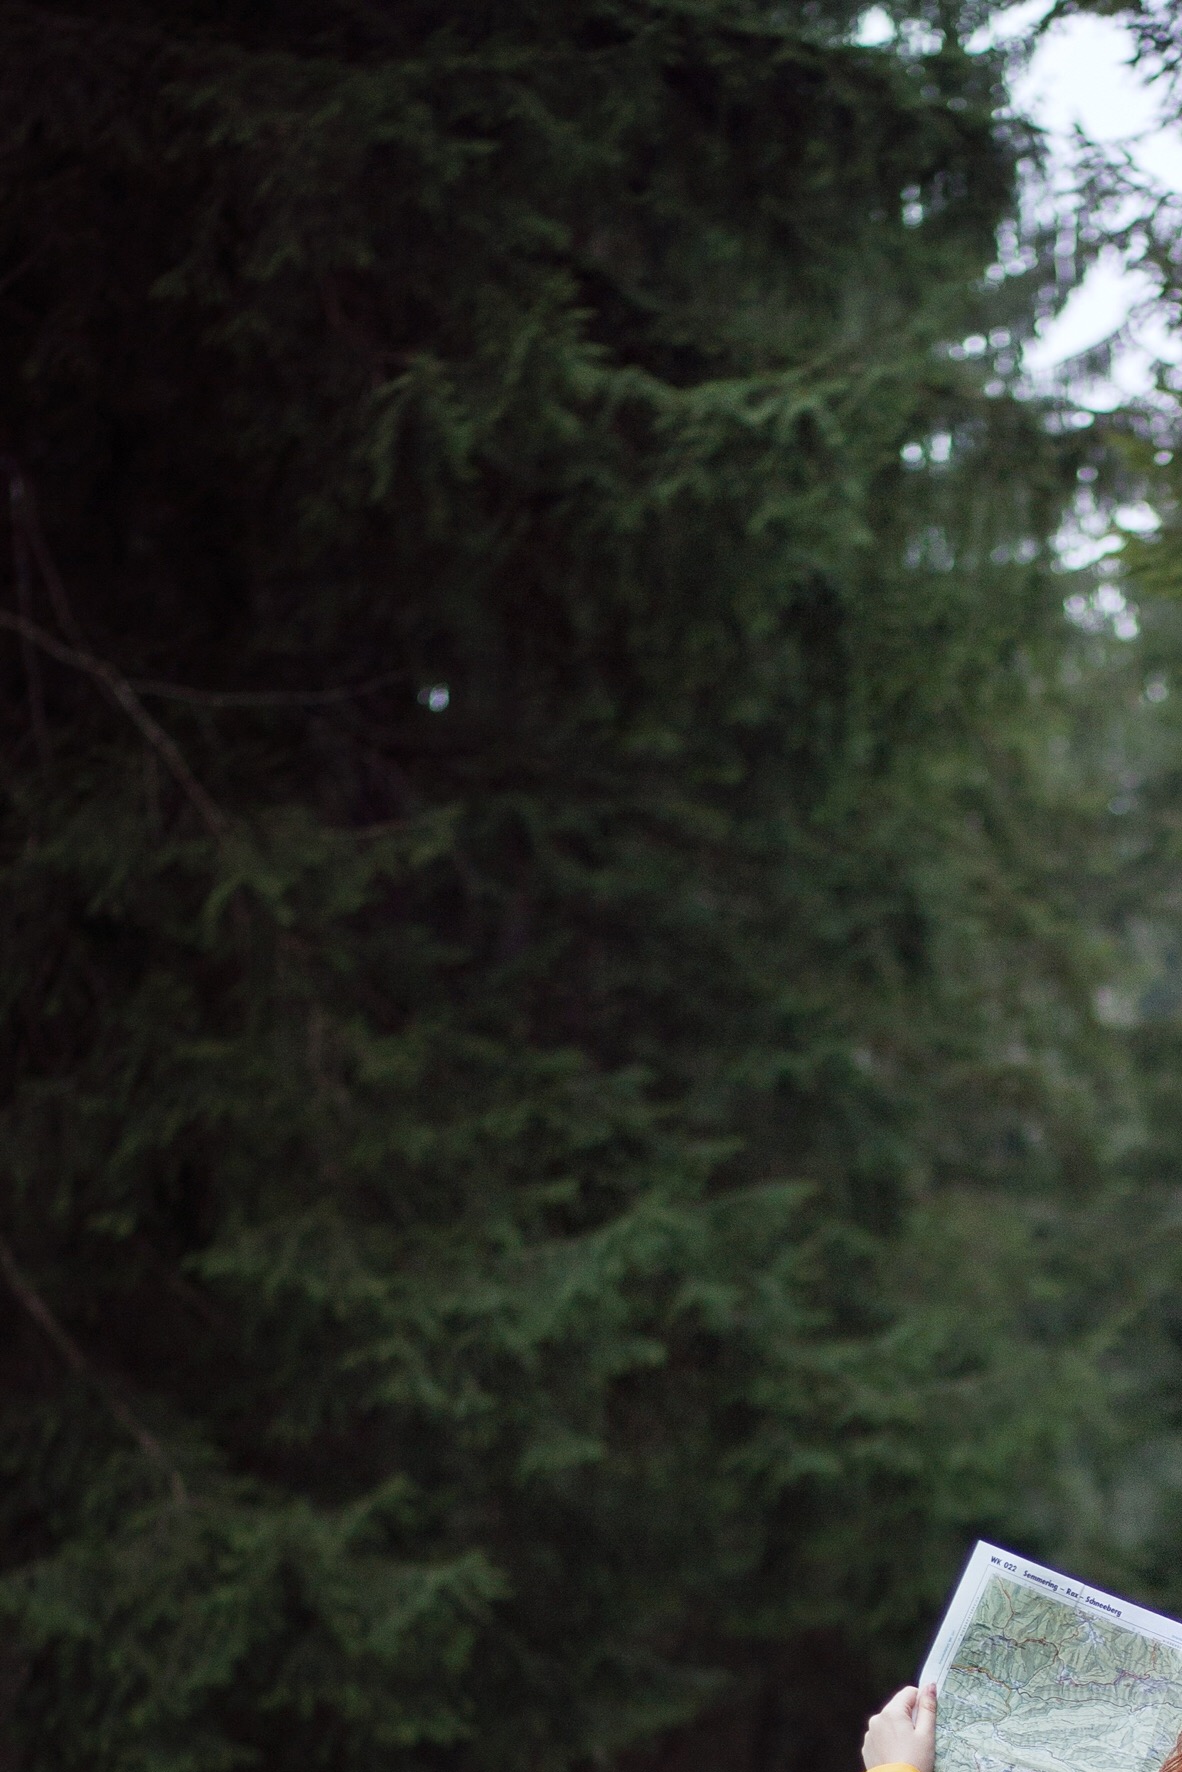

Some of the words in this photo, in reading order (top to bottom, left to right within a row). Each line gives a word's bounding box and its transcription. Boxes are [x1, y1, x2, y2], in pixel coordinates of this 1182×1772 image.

[990, 1555, 1002, 1566] WK
[1003, 1562, 1018, 1573] 022
[1023, 1570, 1059, 1592] Semmering
[1066, 1588, 1079, 1599] Rax
[1085, 1596, 1122, 1617] Schneeberg
